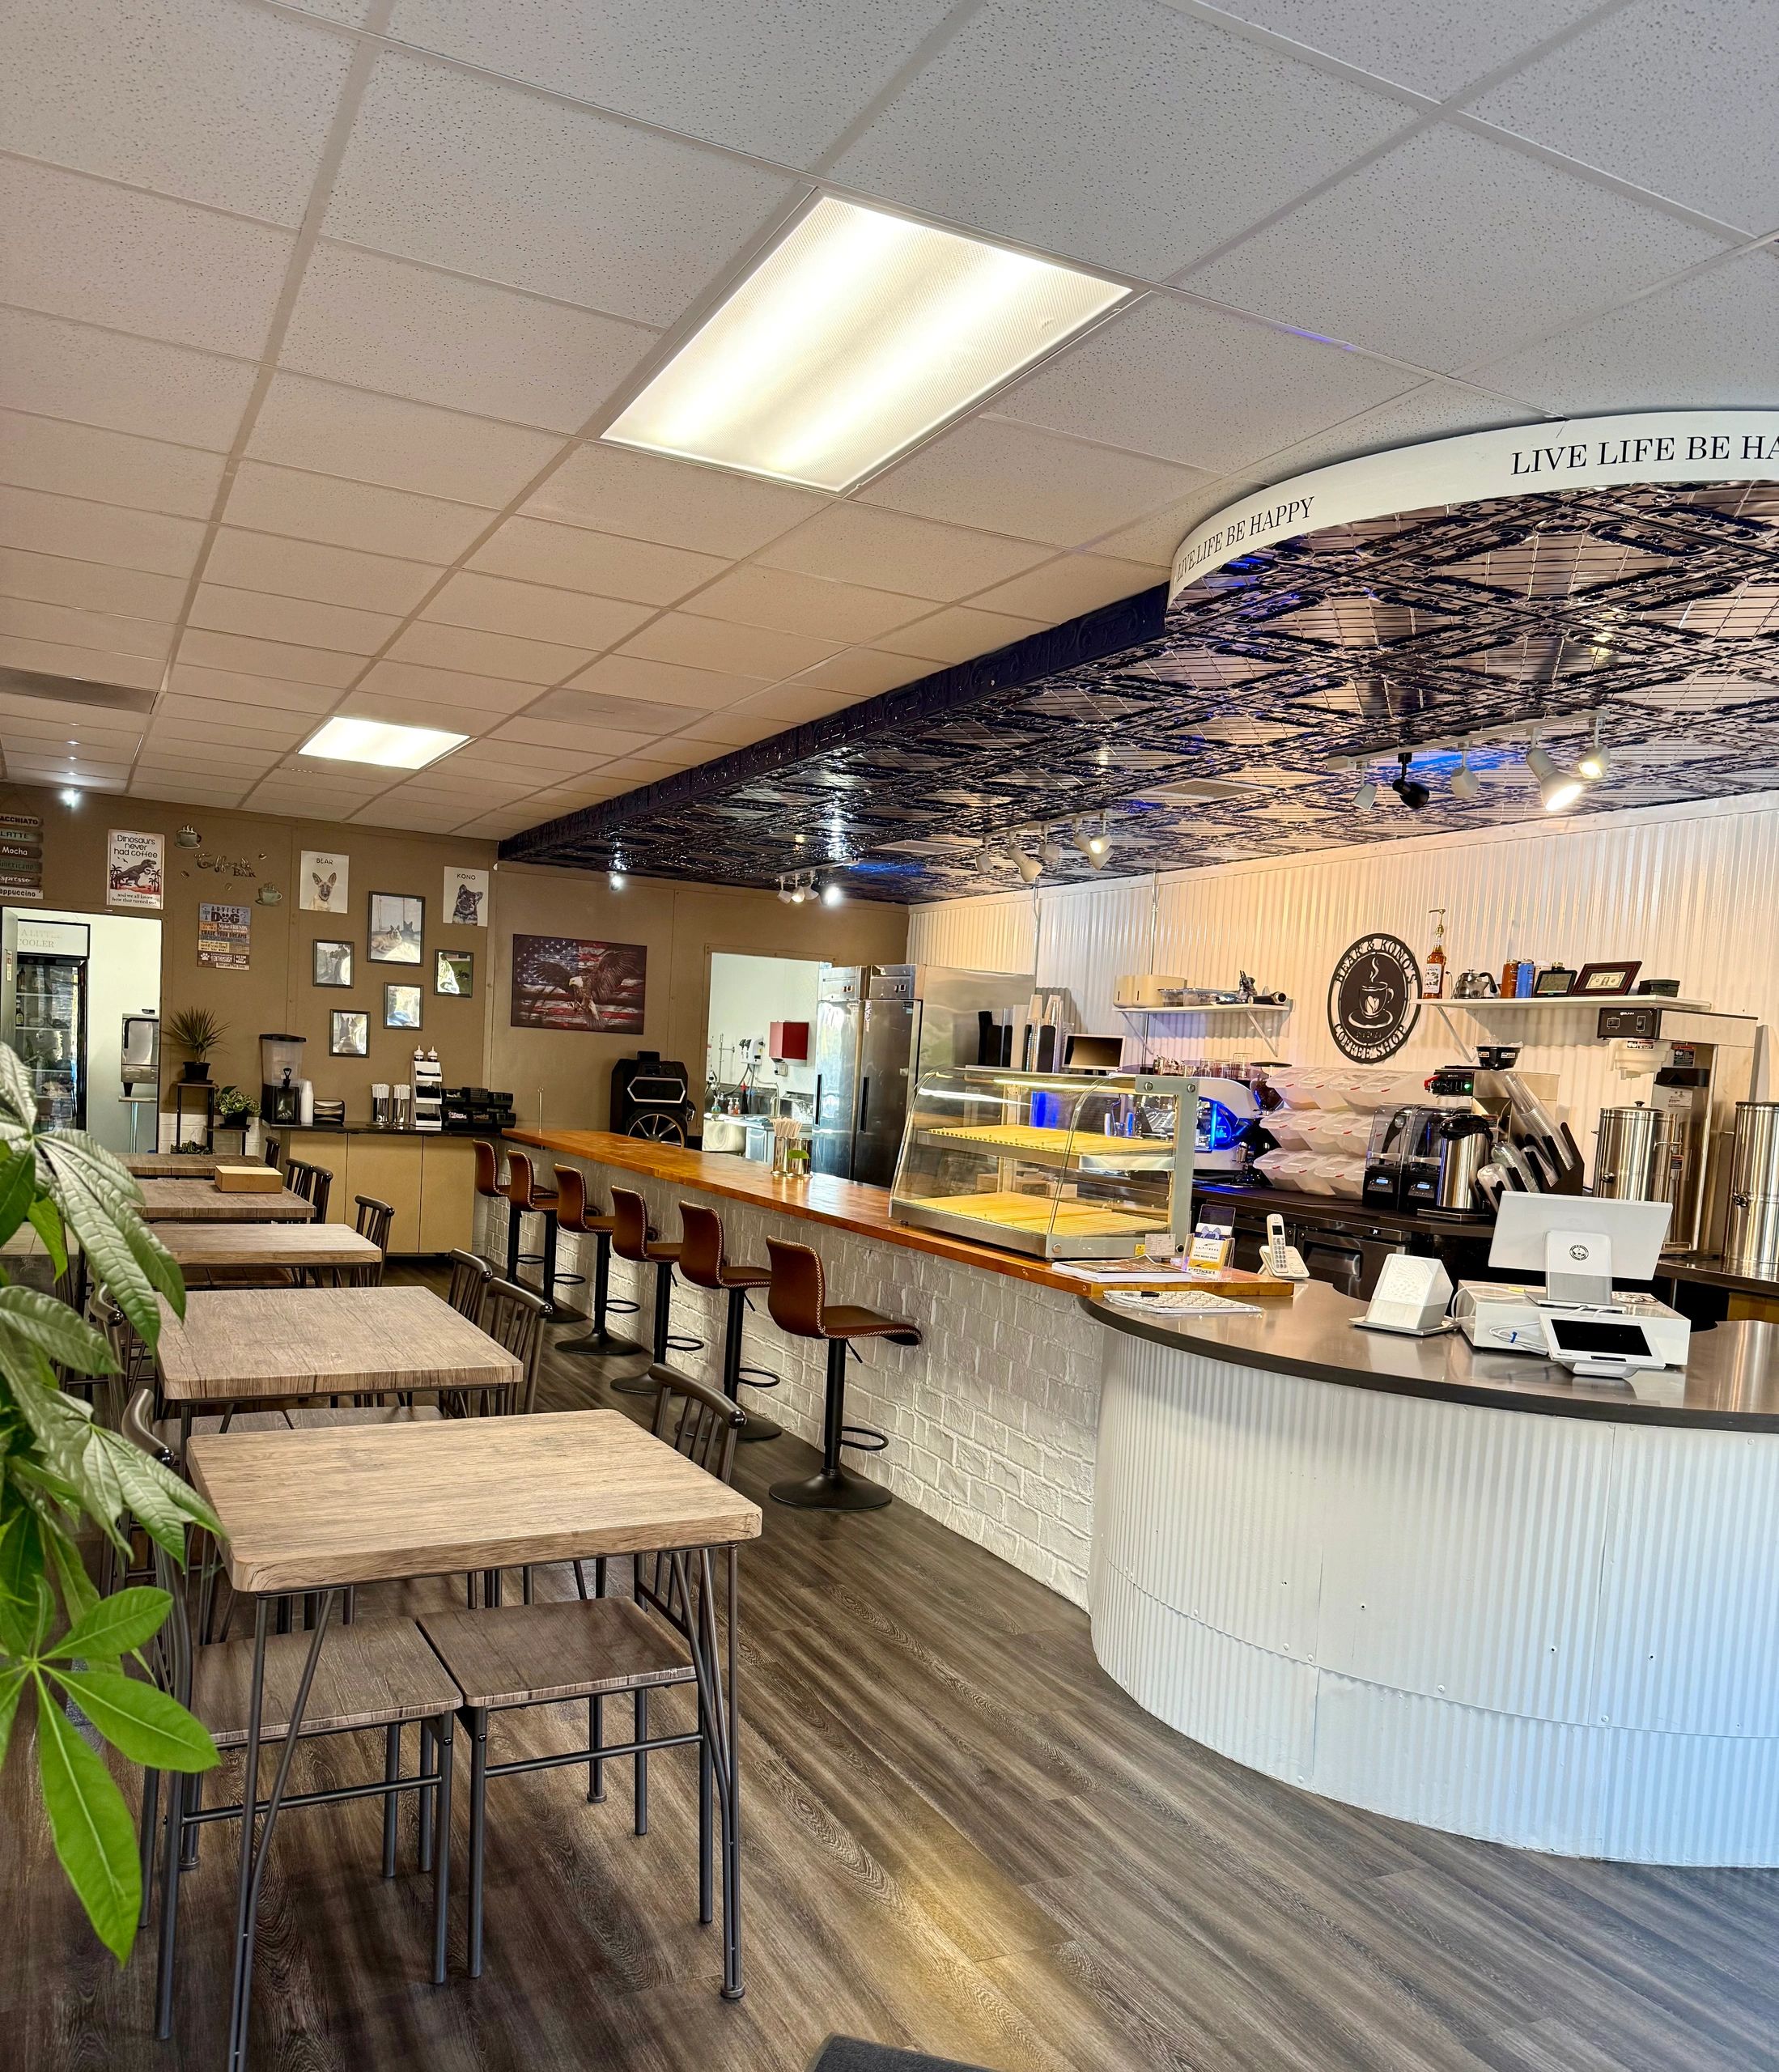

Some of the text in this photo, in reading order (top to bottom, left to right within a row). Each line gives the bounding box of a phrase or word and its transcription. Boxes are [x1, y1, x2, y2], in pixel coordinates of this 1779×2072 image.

[1510, 444, 1587, 476] LIVE
[1597, 437, 1675, 465] LIFE
[1685, 435, 1730, 461] BE
[1176, 495, 1316, 583] LIVE LIFE BE HAPPY
[0, 830, 30, 839] LATTE
[117, 834, 156, 845] Dinosaurs
[2, 846, 28, 856] Mocha
[125, 843, 147, 851] never
[113, 847, 159, 859] had coffee
[316, 857, 333, 865] BEAR
[0, 875, 32, 884] spresso
[210, 906, 240, 914] ADVICE
[1334, 1023, 1406, 1059] COFFEE SHOP
